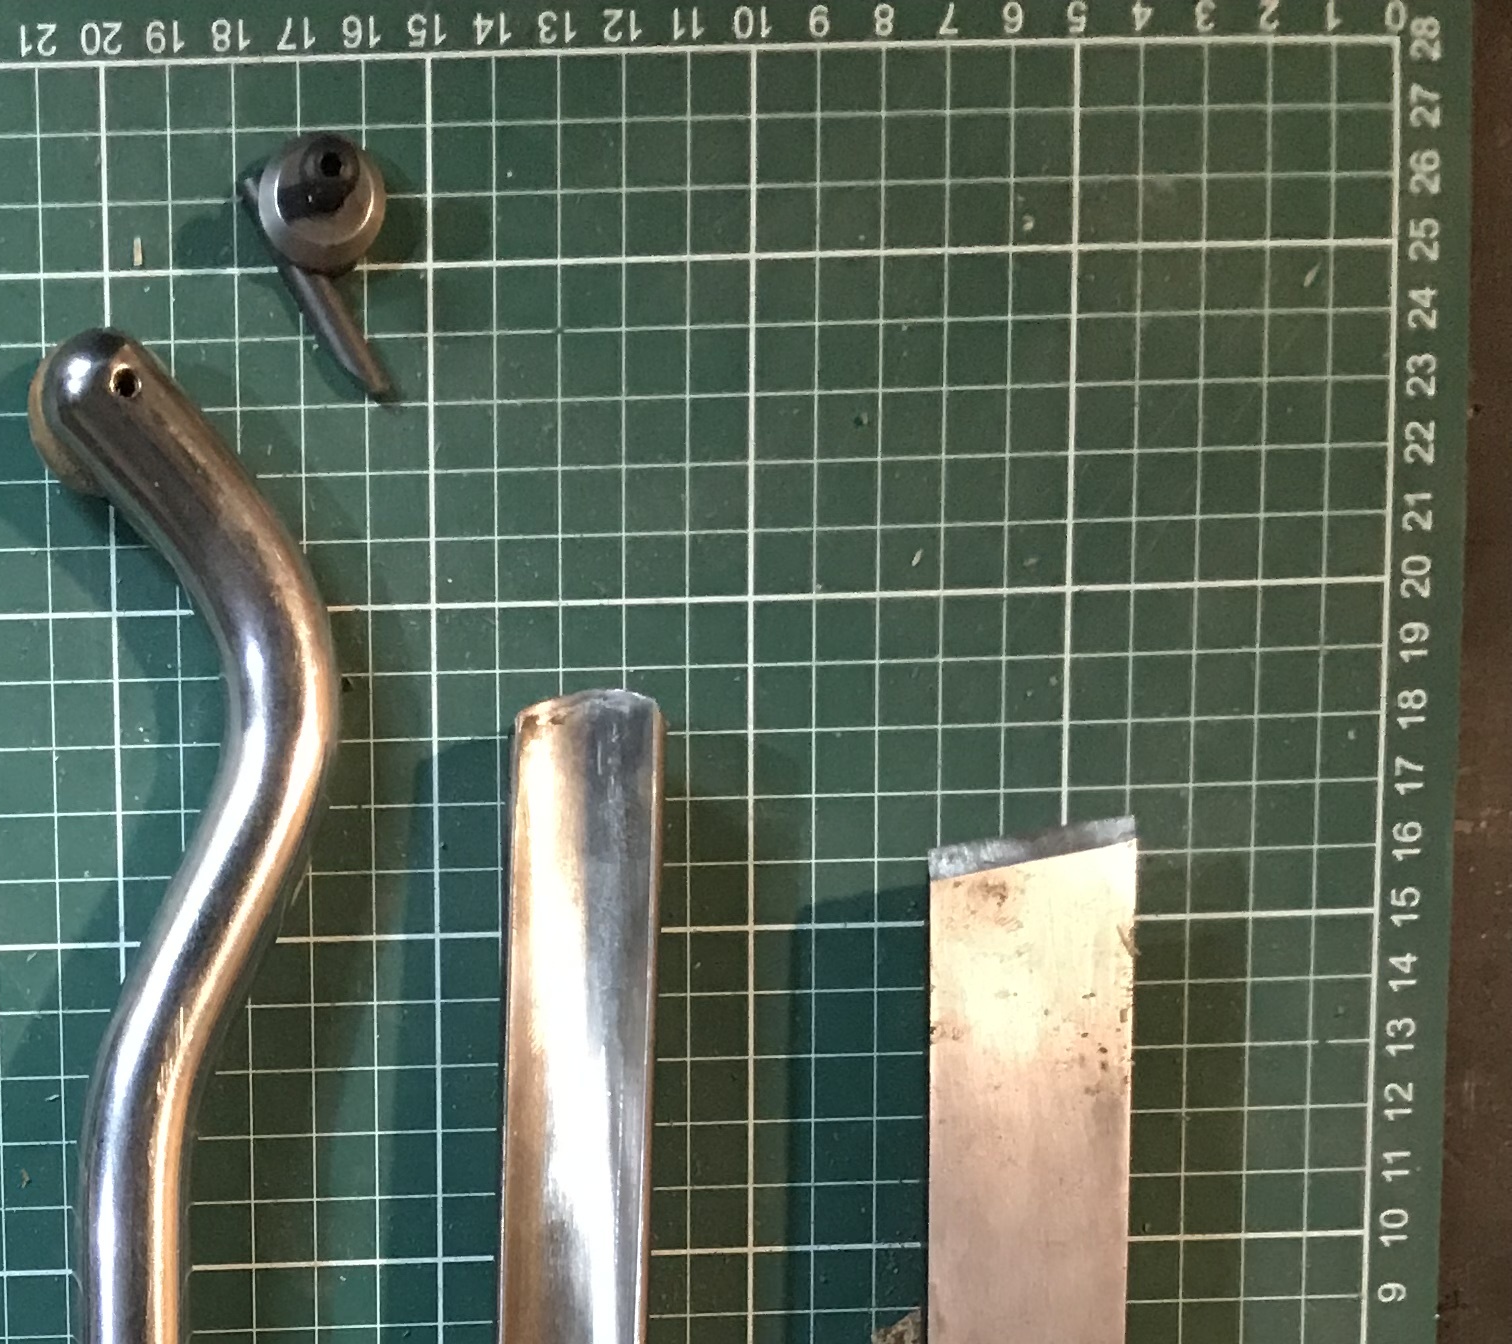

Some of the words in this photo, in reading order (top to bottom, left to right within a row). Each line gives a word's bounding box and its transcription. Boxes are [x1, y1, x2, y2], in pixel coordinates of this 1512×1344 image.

[276, 16, 316, 51] 17
[341, 15, 381, 49] 16
[407, 13, 447, 48] 15
[473, 12, 512, 46] 14
[537, 10, 577, 45] 13
[603, 8, 643, 43] 12
[673, 7, 705, 41] 11
[733, 5, 772, 40] 10
[808, 4, 830, 38] 9
[873, 3, 895, 37] 8
[938, 2, 959, 36] 7
[1002, 1, 1024, 34] 6
[1066, 0, 1087, 35] 5
[1131, 0, 1153, 32] 4
[1194, 0, 1216, 33] 3
[1259, 0, 1280, 33] 2
[1326, 0, 1341, 32] 1
[1384, 0, 1408, 34] 0
[20, 23, 57, 58] 21
[80, 21, 122, 56] 20
[145, 20, 185, 54] 19
[211, 18, 251, 52] 18
[1409, 16, 1442, 62] 28
[1409, 82, 1441, 129] 27
[1409, 149, 1441, 195] 26
[1408, 217, 1440, 261] 25
[1407, 286, 1438, 329] 24
[1405, 352, 1437, 397] 23
[1403, 420, 1436, 465] 22
[1401, 492, 1433, 532] 21
[1399, 554, 1432, 599] 20
[1398, 621, 1430, 663] 19
[1396, 688, 1428, 730] 18
[1394, 756, 1424, 796] 17
[1391, 821, 1422, 862] 16
[1389, 886, 1421, 928] 15
[1388, 952, 1418, 992] 14
[1385, 1017, 1416, 1057] 13
[1383, 1082, 1414, 1121] 12
[1381, 1151, 1411, 1182] 11
[1378, 1208, 1409, 1247] 10
[1377, 1282, 1406, 1303] 9
